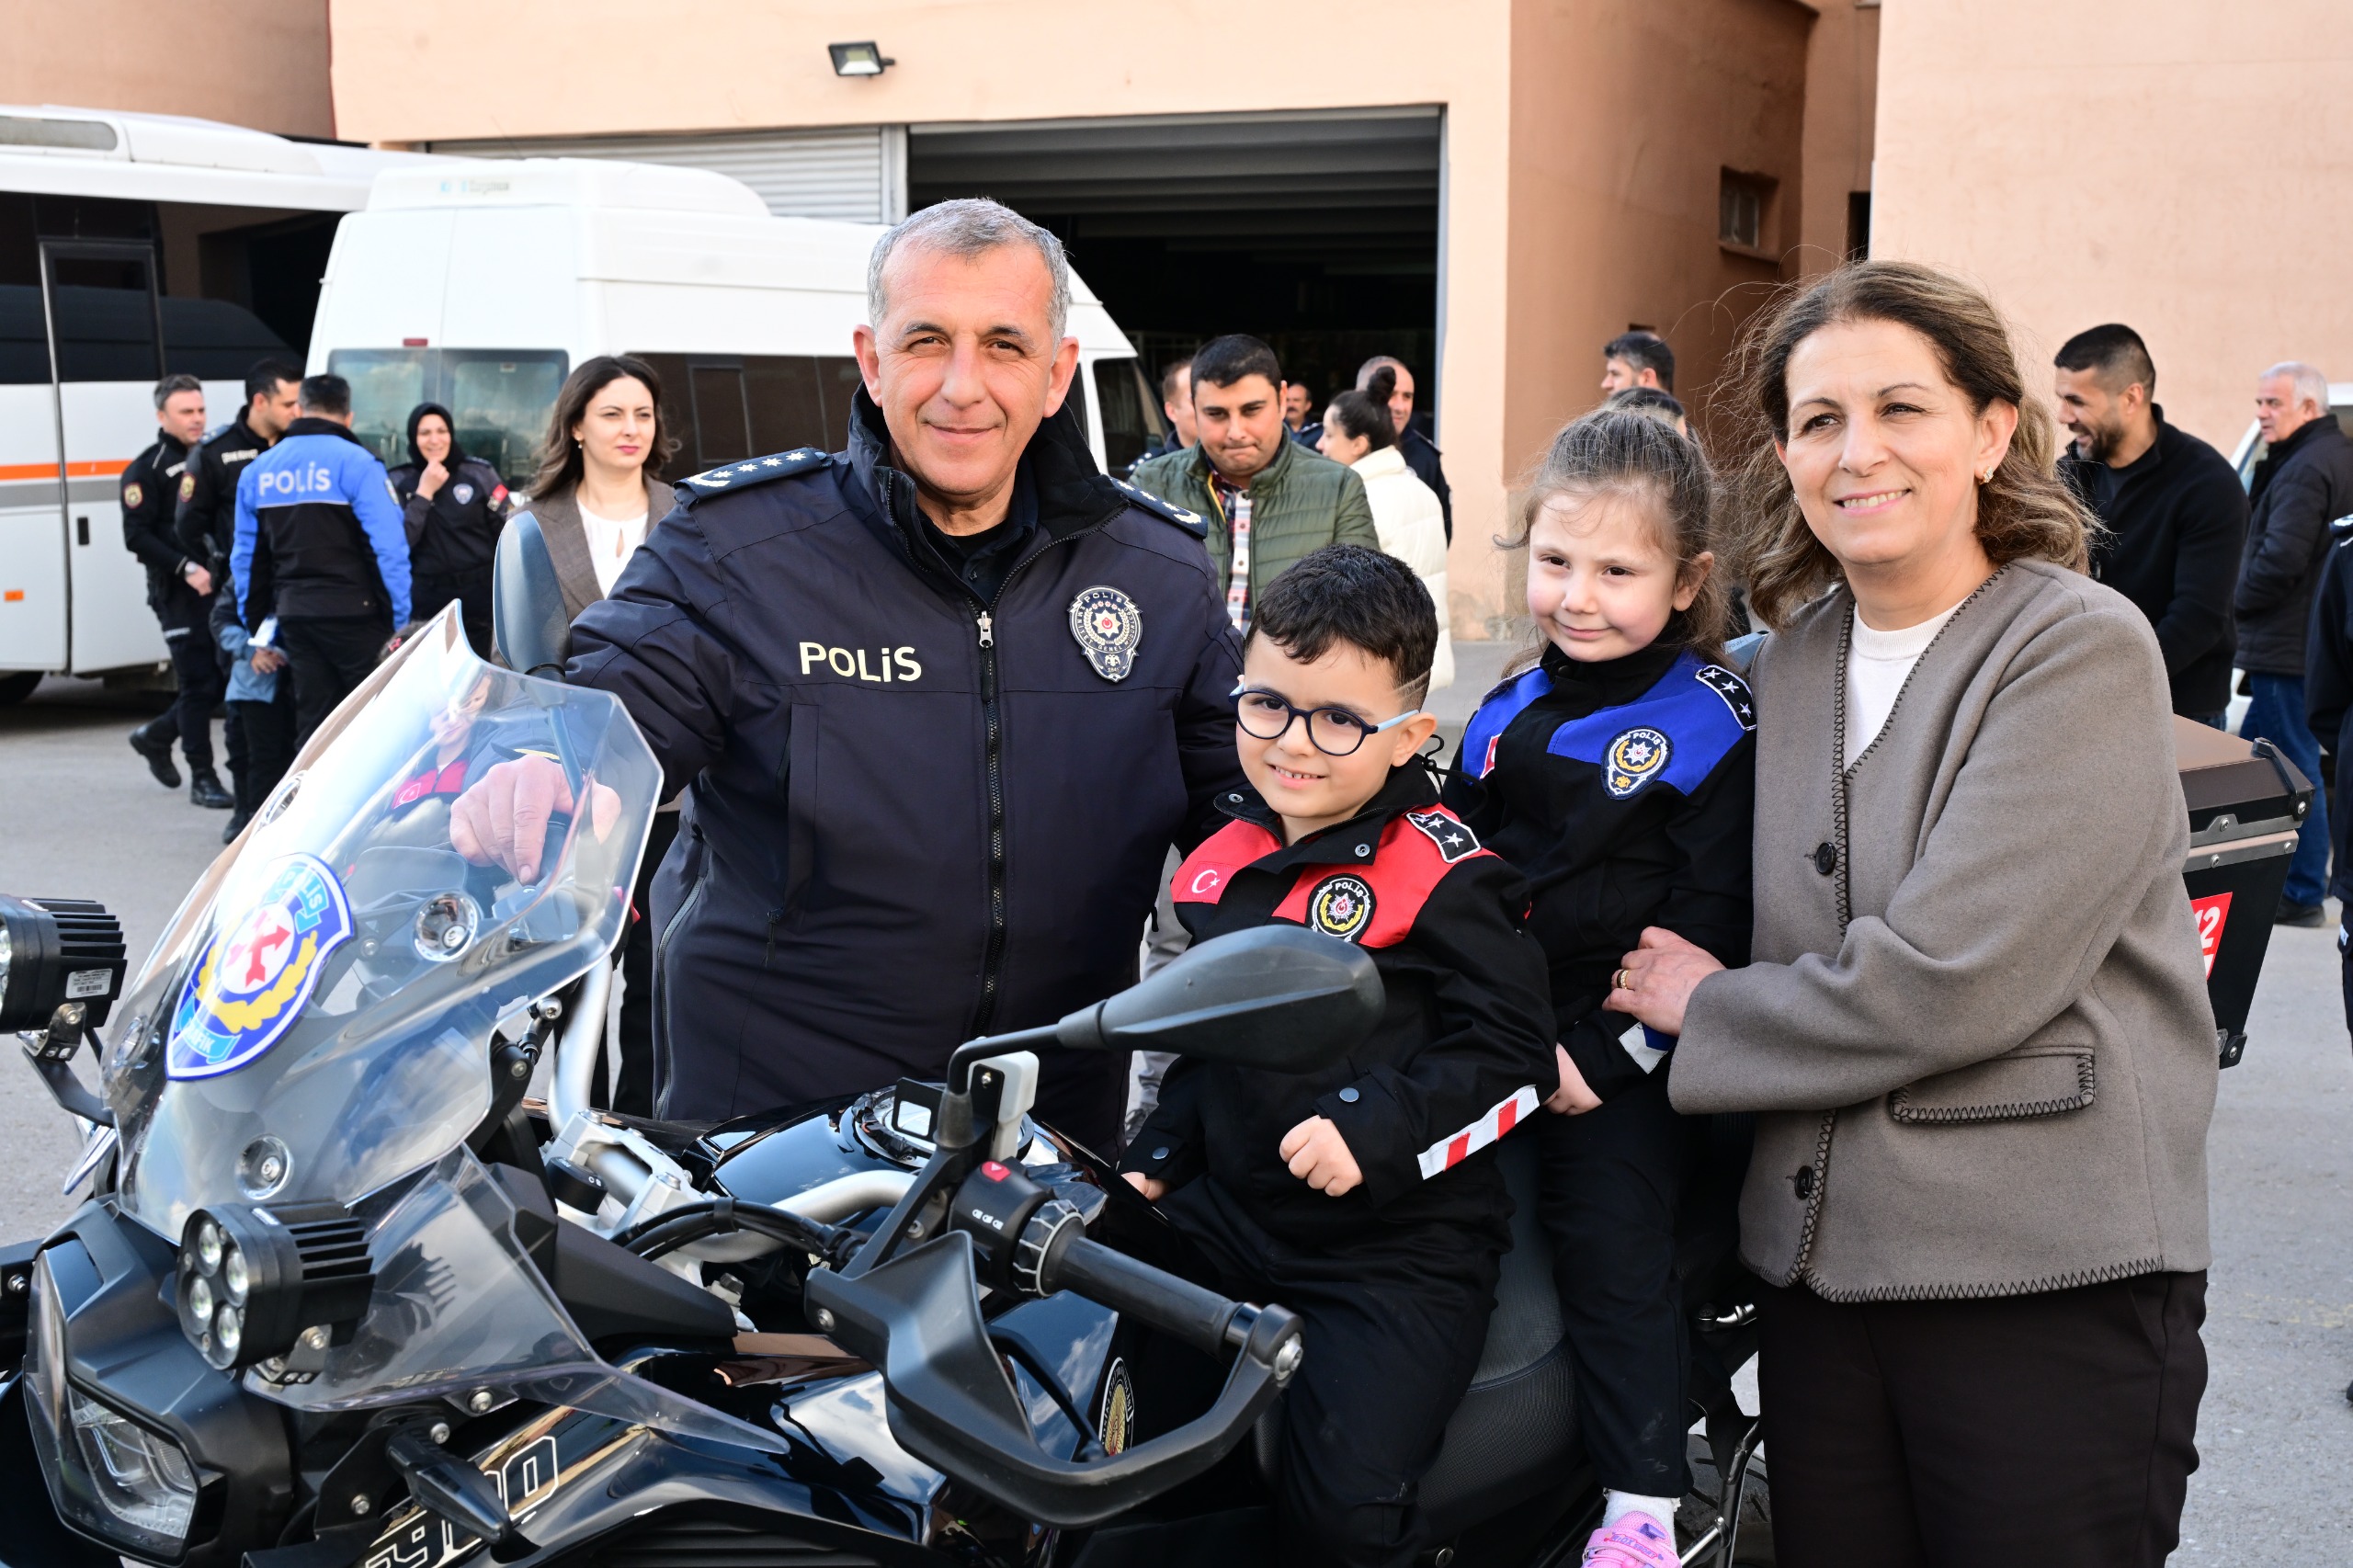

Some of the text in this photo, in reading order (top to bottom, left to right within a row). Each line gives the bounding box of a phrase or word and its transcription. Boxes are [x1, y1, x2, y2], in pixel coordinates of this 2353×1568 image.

[258, 461, 332, 496] POLİS
[1084, 592, 1122, 604] POLİS
[799, 642, 922, 683] POLİS
[1632, 732, 1661, 745] POLİS
[1335, 881, 1364, 898] POLİS
